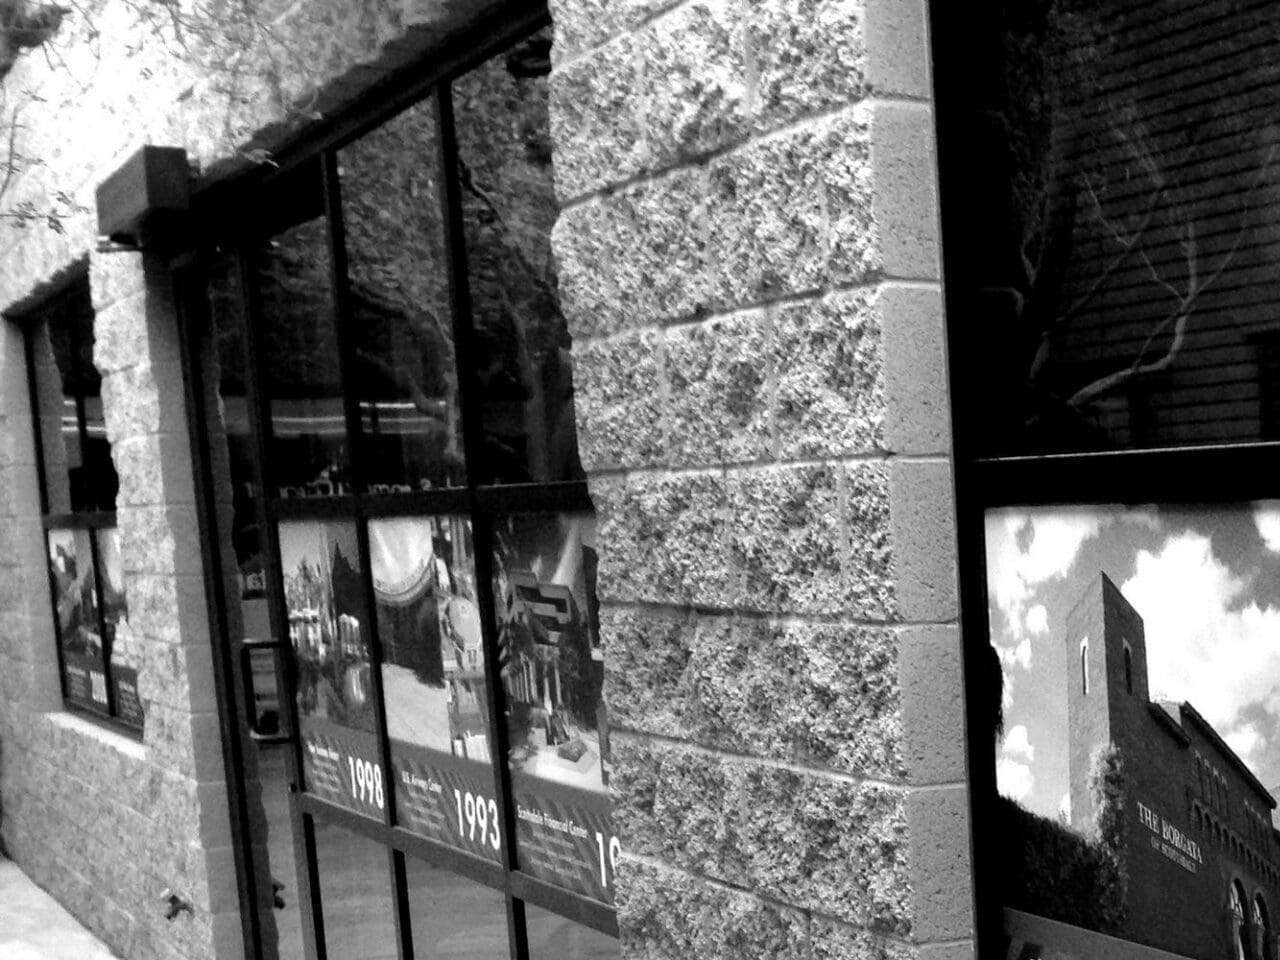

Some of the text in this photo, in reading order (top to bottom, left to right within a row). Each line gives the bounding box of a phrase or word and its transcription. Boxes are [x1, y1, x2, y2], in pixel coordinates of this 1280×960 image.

[348, 755, 384, 810] 1998
[454, 788, 501, 851] 1993
[1136, 800, 1160, 834] THE
[1161, 818, 1204, 865] BORGATA
